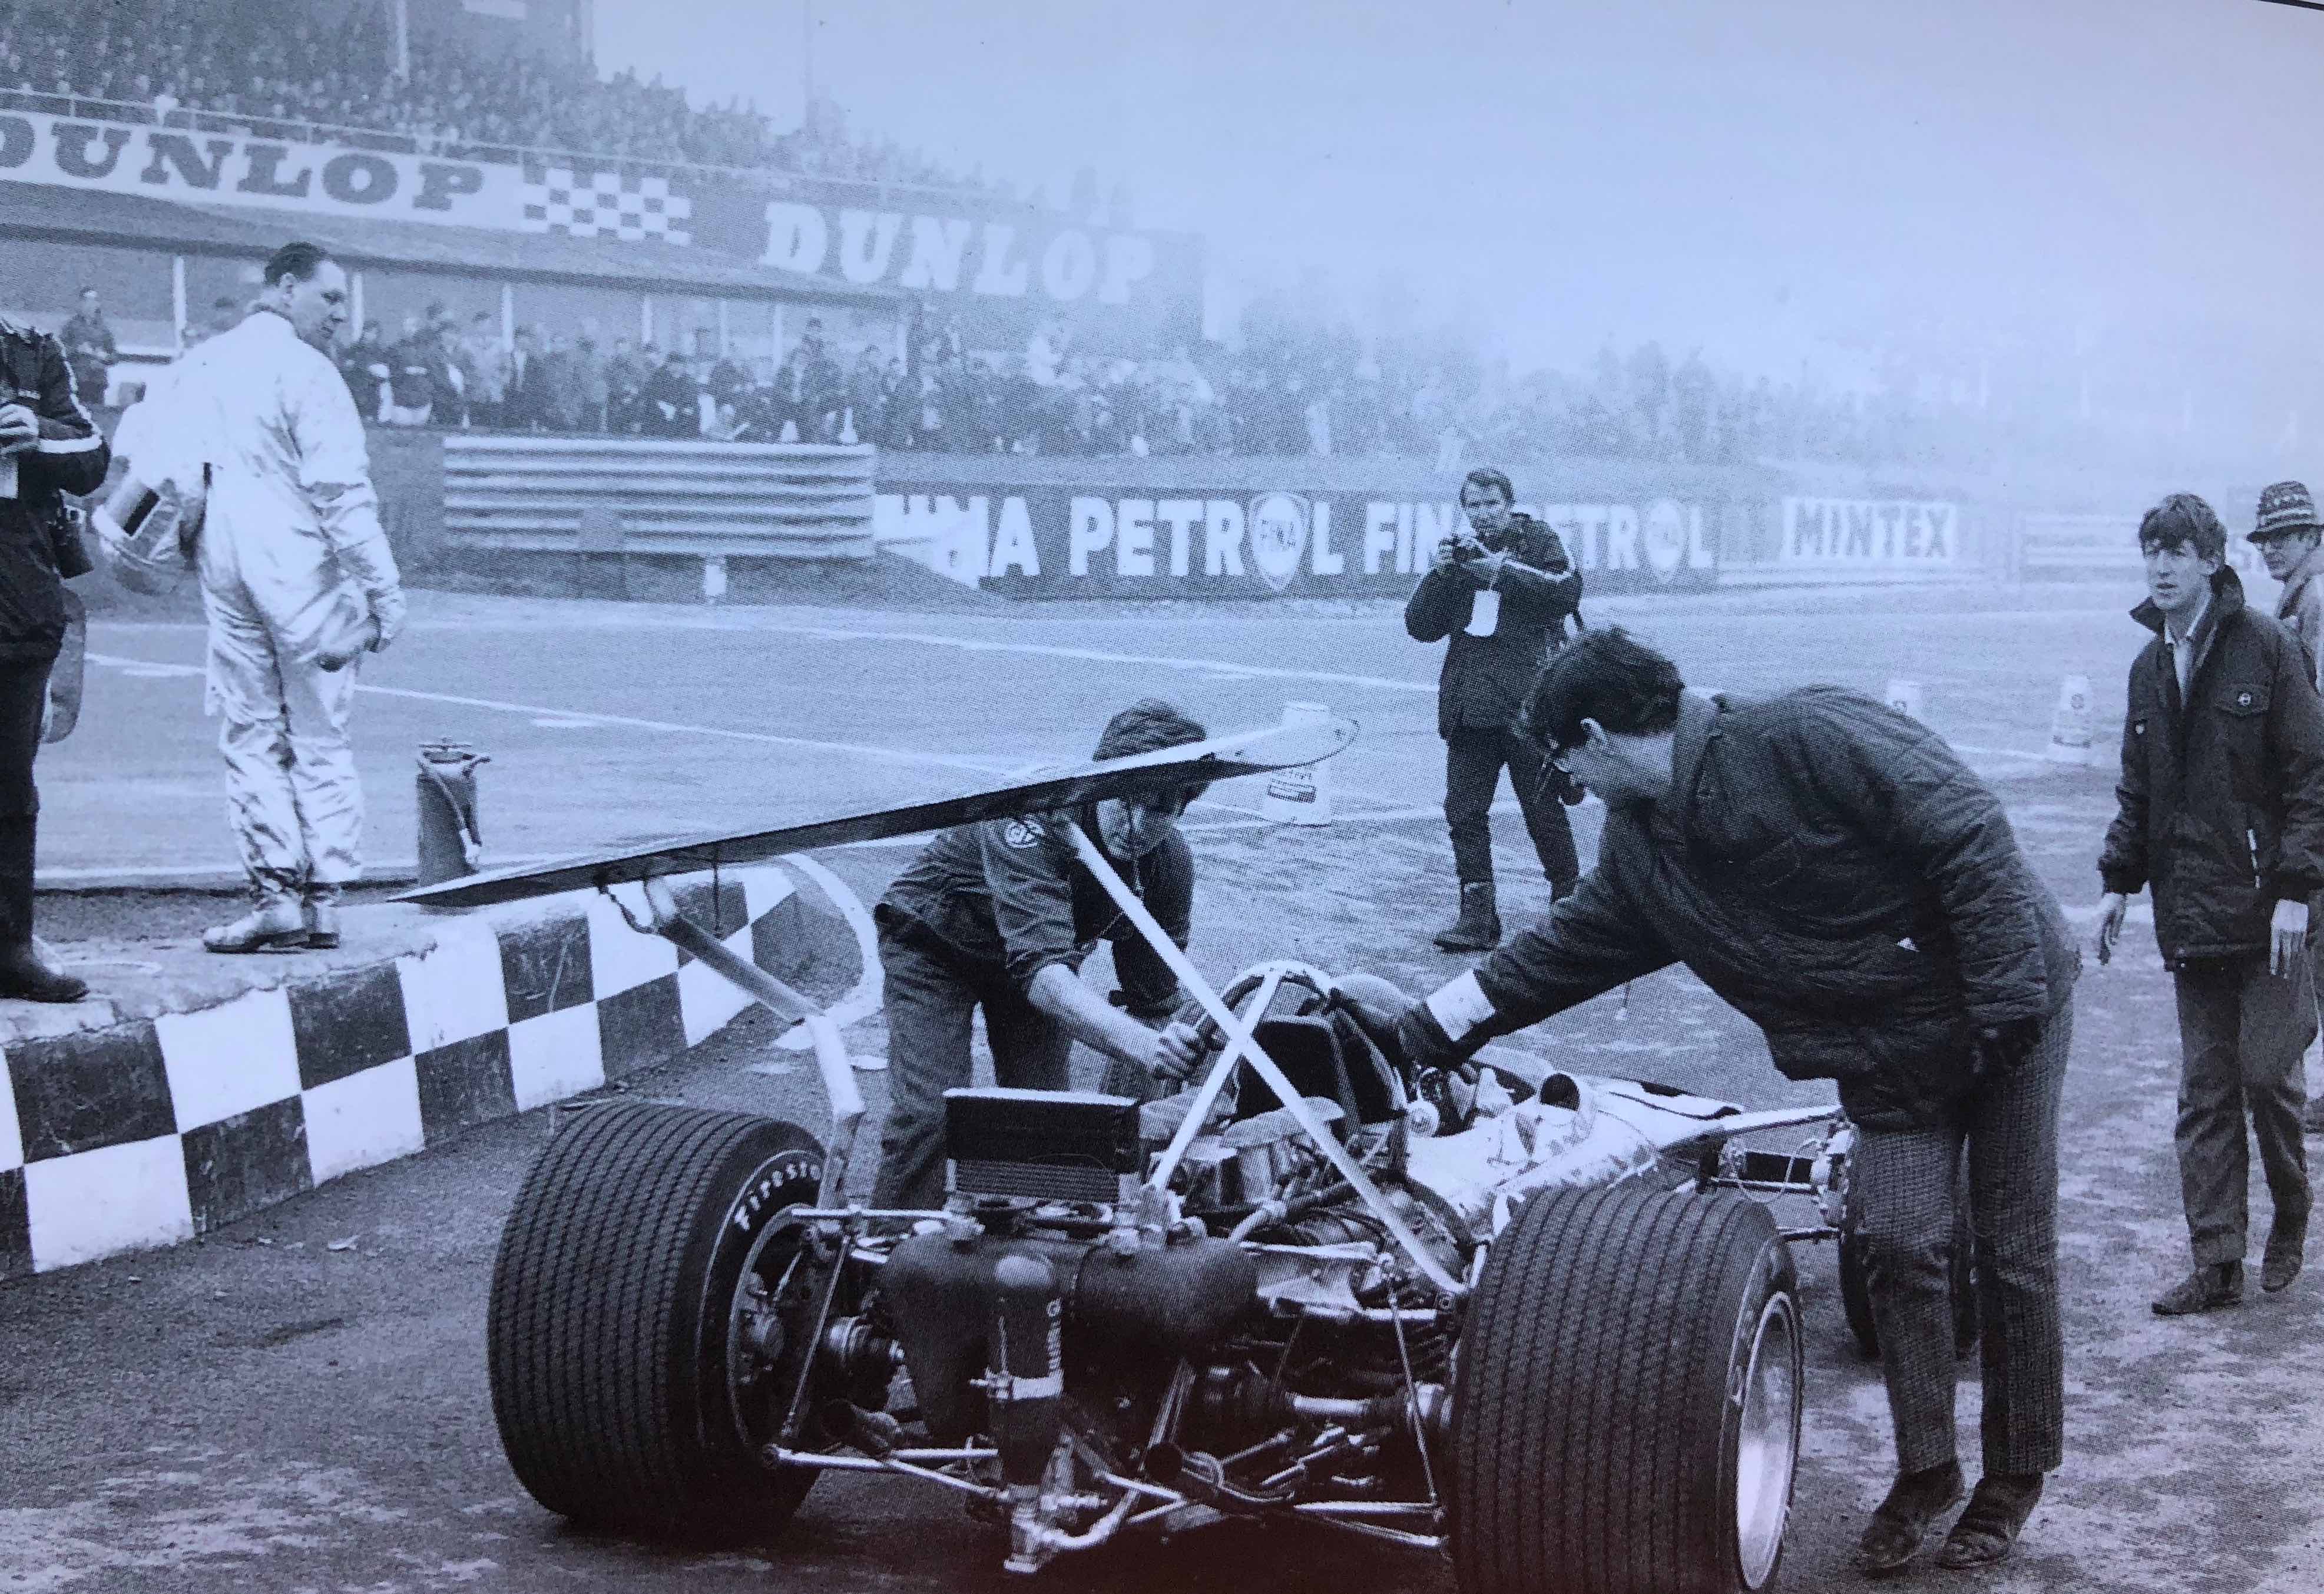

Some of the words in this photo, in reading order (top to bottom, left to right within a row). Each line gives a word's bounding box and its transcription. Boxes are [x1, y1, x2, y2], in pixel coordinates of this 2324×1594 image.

[759, 201, 1154, 305] DUNLOP
[1069, 495, 1344, 584] PETROL
[1363, 502, 1474, 574] FIN
[1511, 496, 1713, 580] TROL
[1793, 501, 1949, 557] MINTEX
